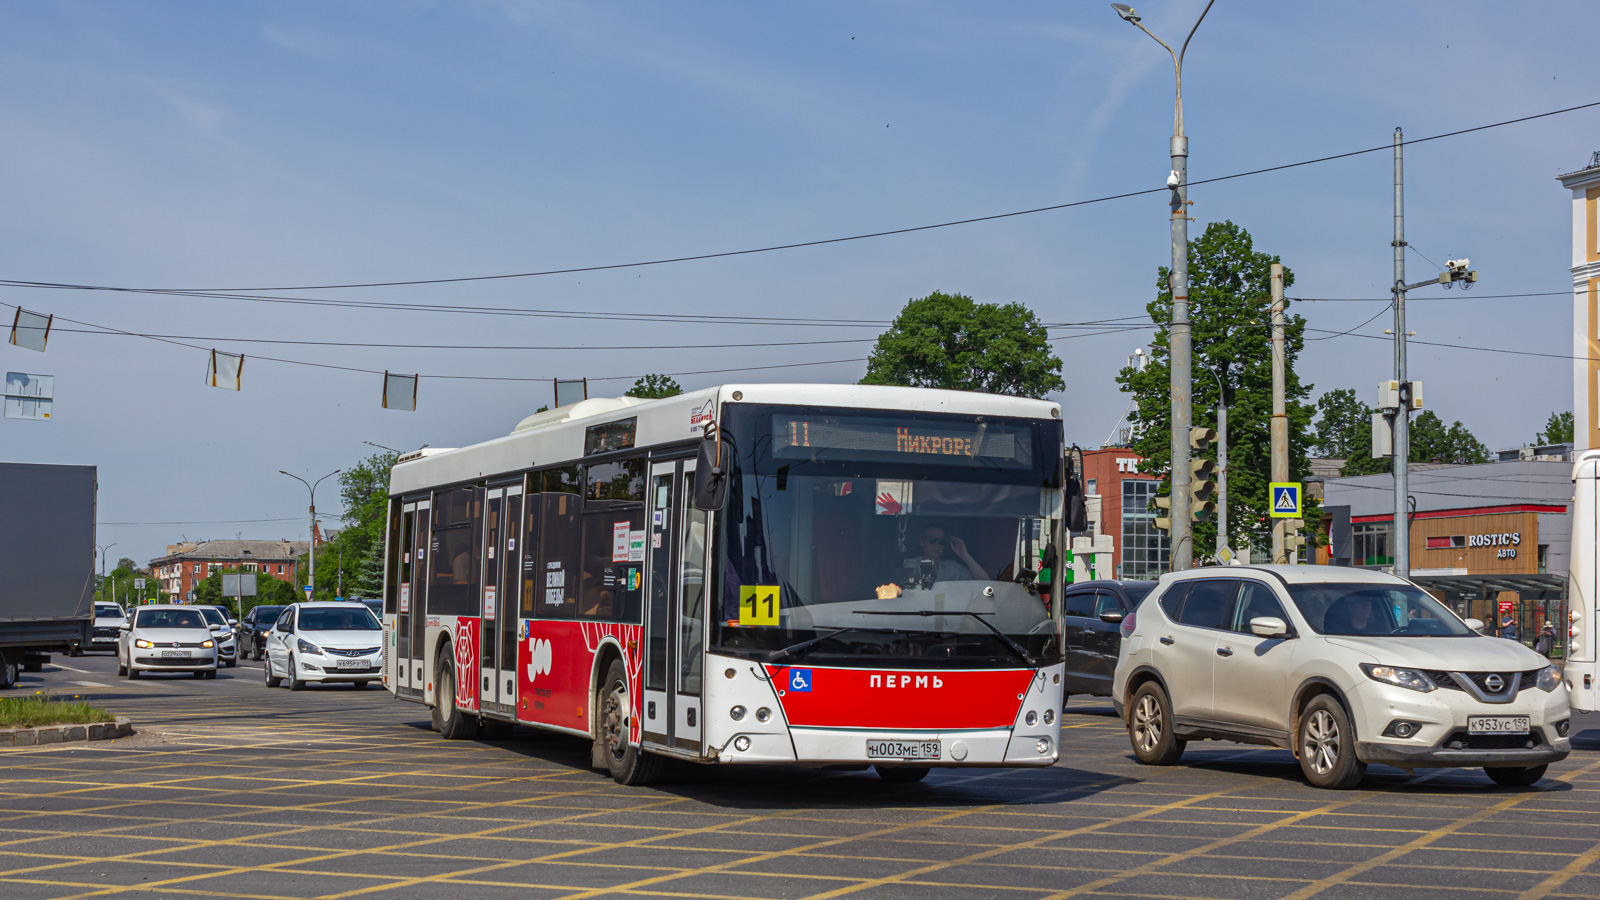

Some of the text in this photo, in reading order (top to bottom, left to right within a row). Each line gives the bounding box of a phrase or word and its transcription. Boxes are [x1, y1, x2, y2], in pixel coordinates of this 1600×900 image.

[791, 421, 810, 446] 11
[1469, 533, 1520, 547] ROSTIC'S
[1497, 549, 1516, 558] АВТО
[746, 593, 773, 618] 11
[527, 638, 552, 682] 300
[870, 674, 943, 688] ПЕРМЬ
[1471, 719, 1527, 731] К953УС 159
[871, 742, 938, 756] Н003МЕ 159
